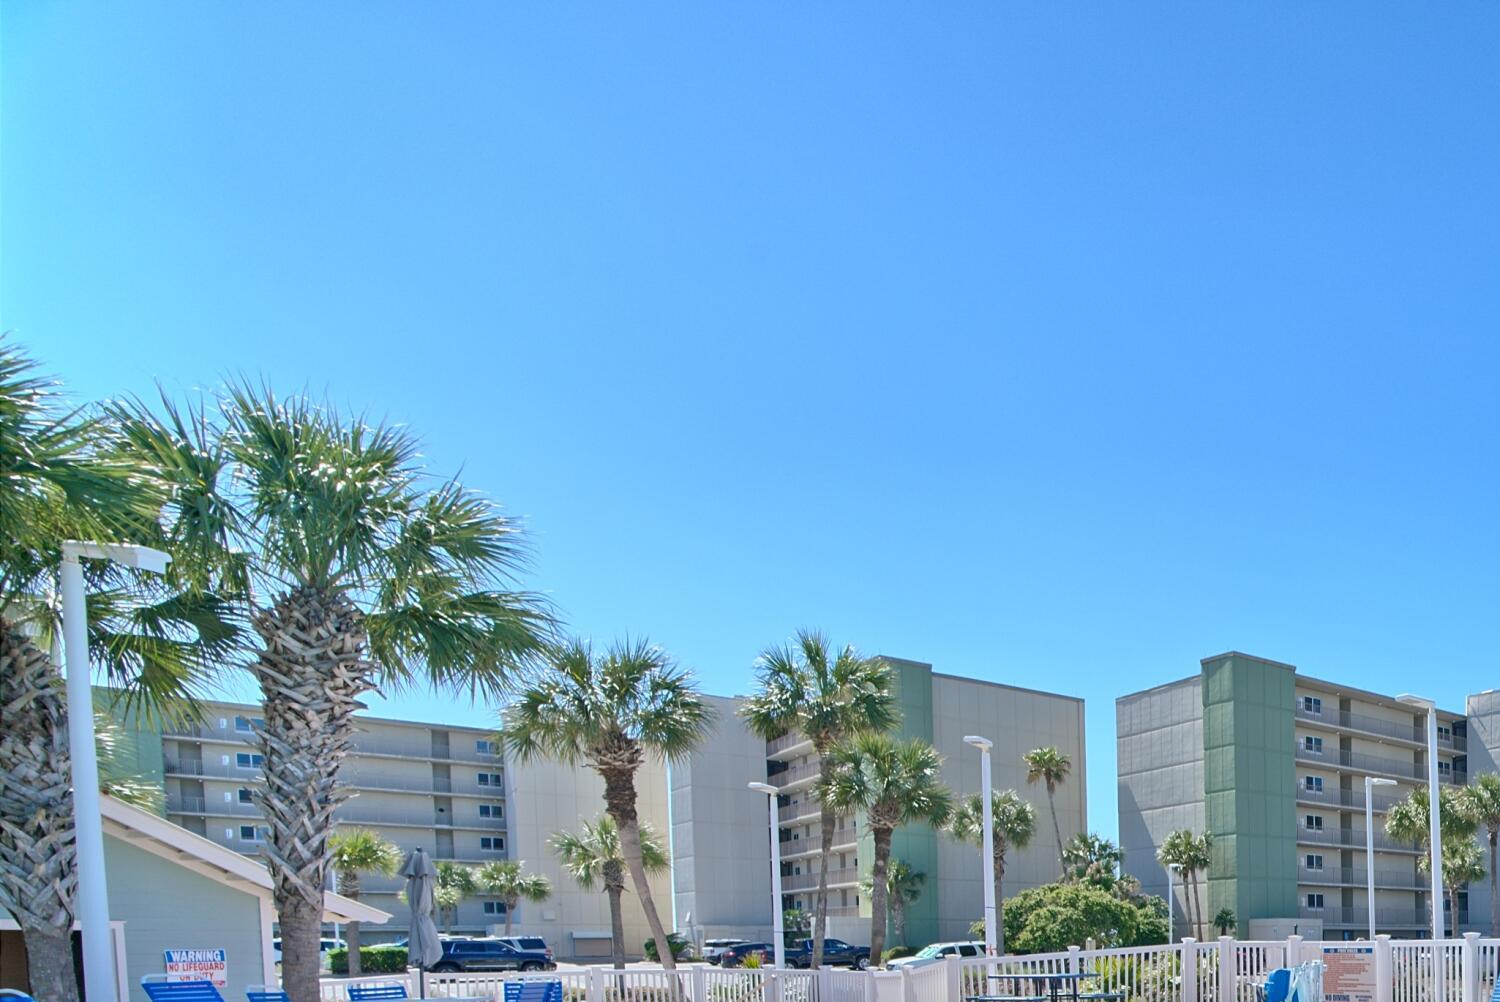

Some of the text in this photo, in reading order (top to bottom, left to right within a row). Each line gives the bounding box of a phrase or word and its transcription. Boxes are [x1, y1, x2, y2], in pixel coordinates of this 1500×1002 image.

[170, 950, 221, 962] WARNING
[168, 962, 224, 972] NO LIFEGUARD
[1333, 994, 1350, 1002] DIVING
